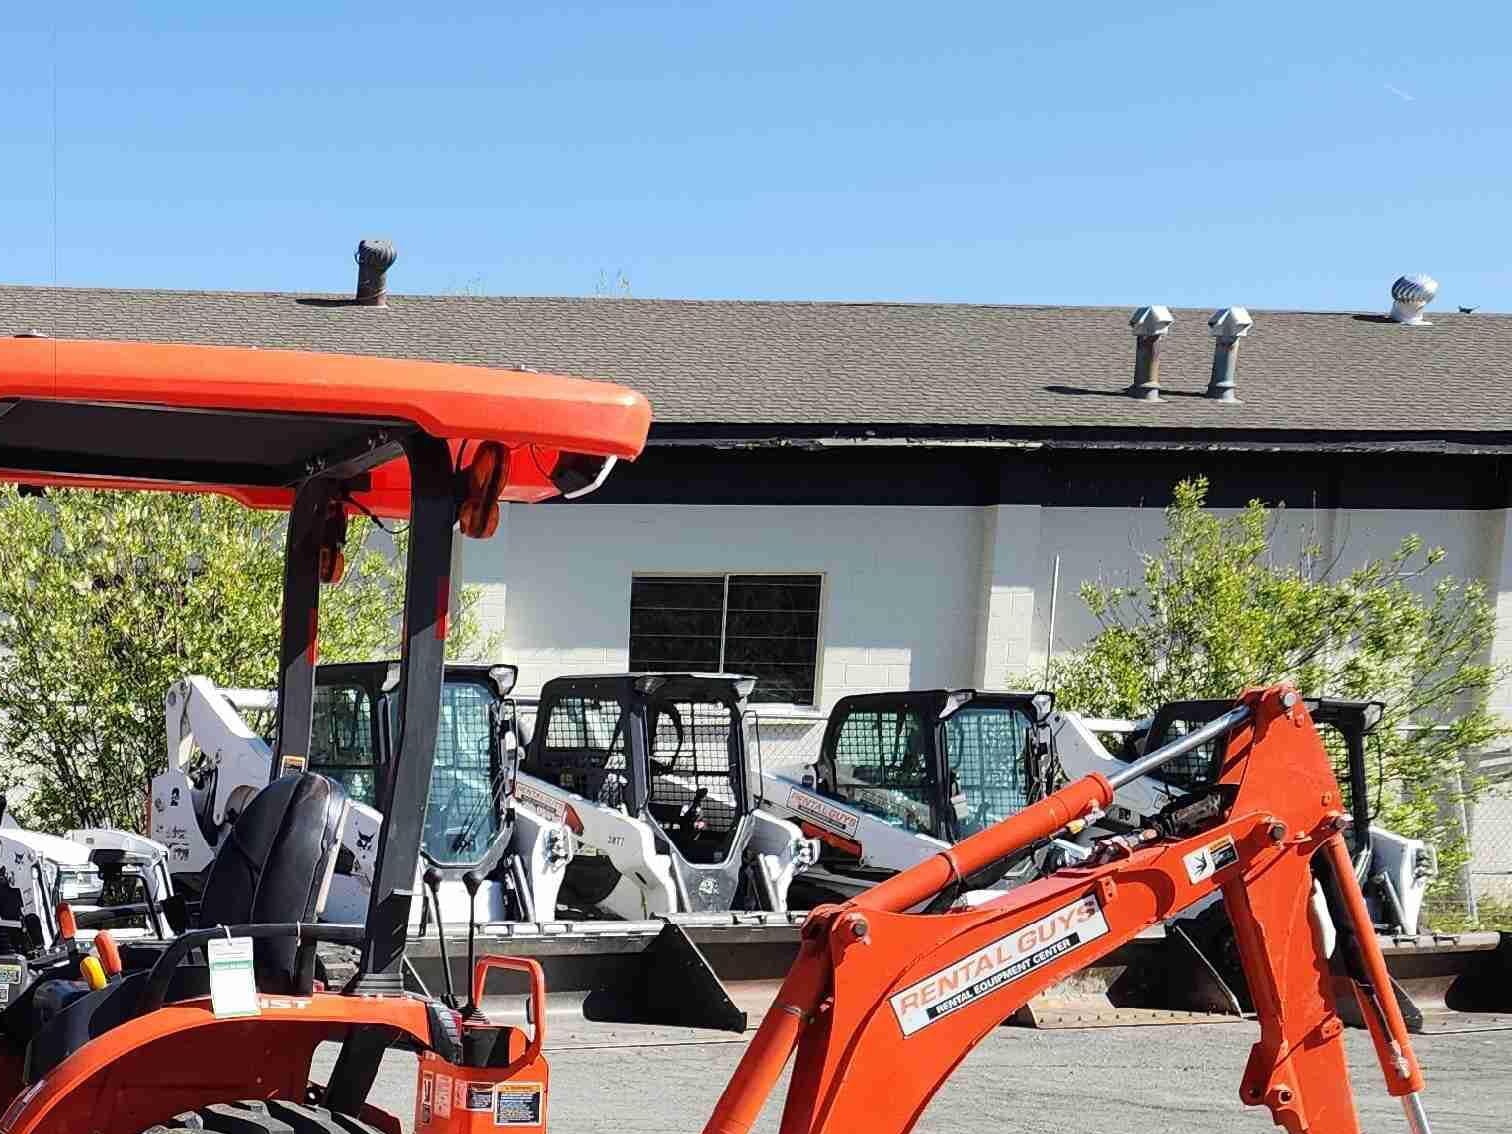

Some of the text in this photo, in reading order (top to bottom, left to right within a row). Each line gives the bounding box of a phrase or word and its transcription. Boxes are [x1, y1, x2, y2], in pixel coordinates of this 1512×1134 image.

[900, 900, 1096, 1016] RENTAL GUYS
[935, 938, 1071, 1014] RENTAL EQUIPMENT CENTER
